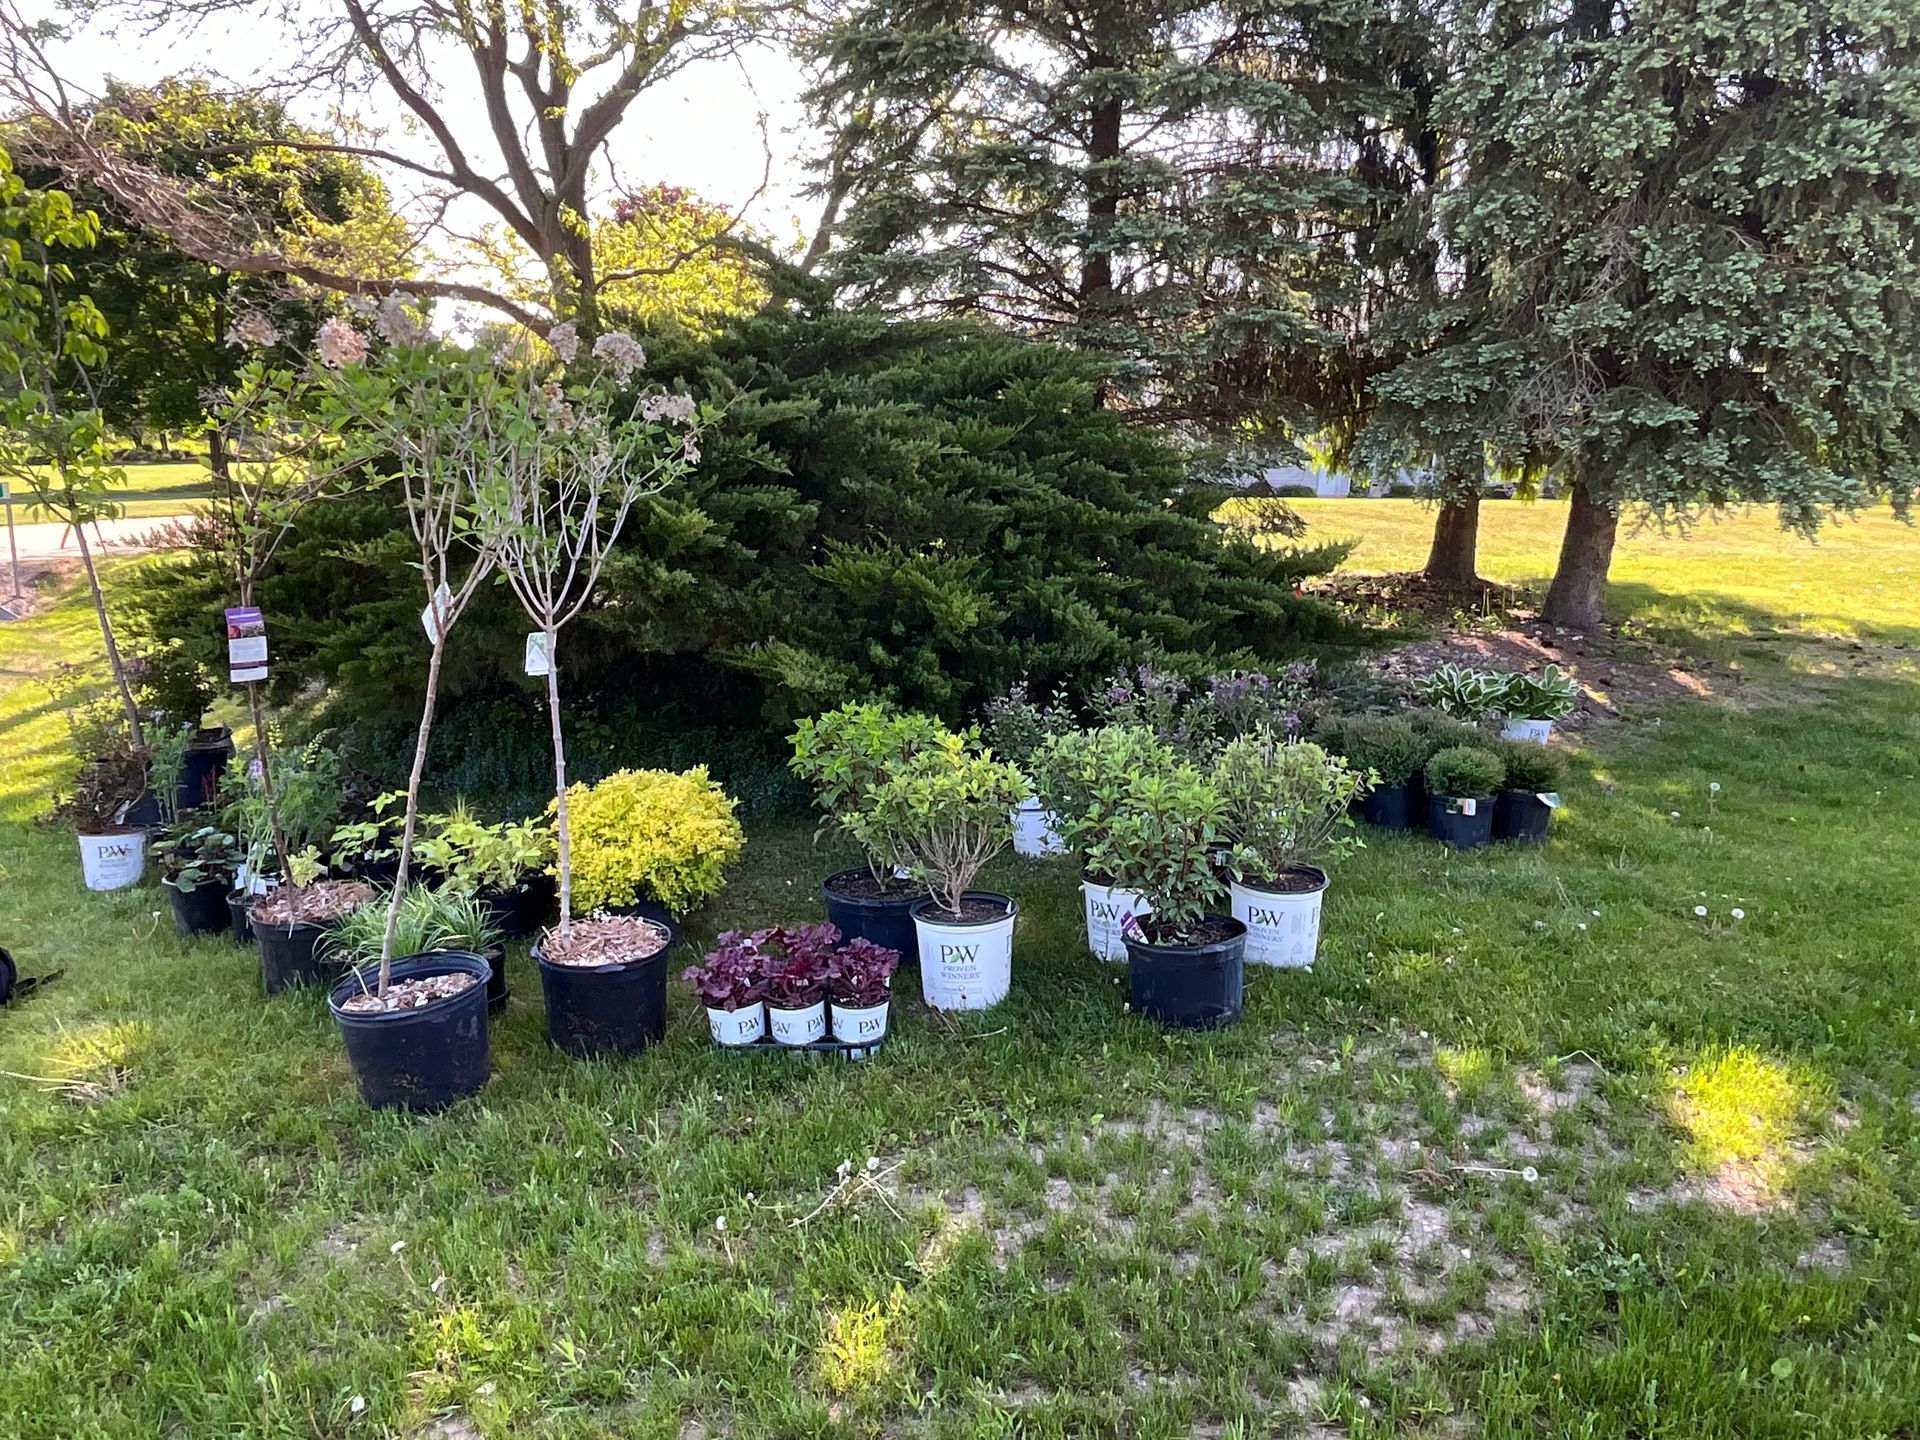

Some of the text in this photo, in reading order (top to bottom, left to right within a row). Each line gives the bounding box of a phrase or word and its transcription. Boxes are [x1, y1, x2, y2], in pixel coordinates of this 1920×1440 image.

[97, 843, 130, 859] PW
[1090, 898, 1120, 921] PW
[1248, 905, 1285, 928] PW
[940, 944, 980, 964] PW
[940, 971, 982, 980] WINNERS
[943, 964, 977, 973] PROVEN
[858, 1015, 883, 1034] PW
